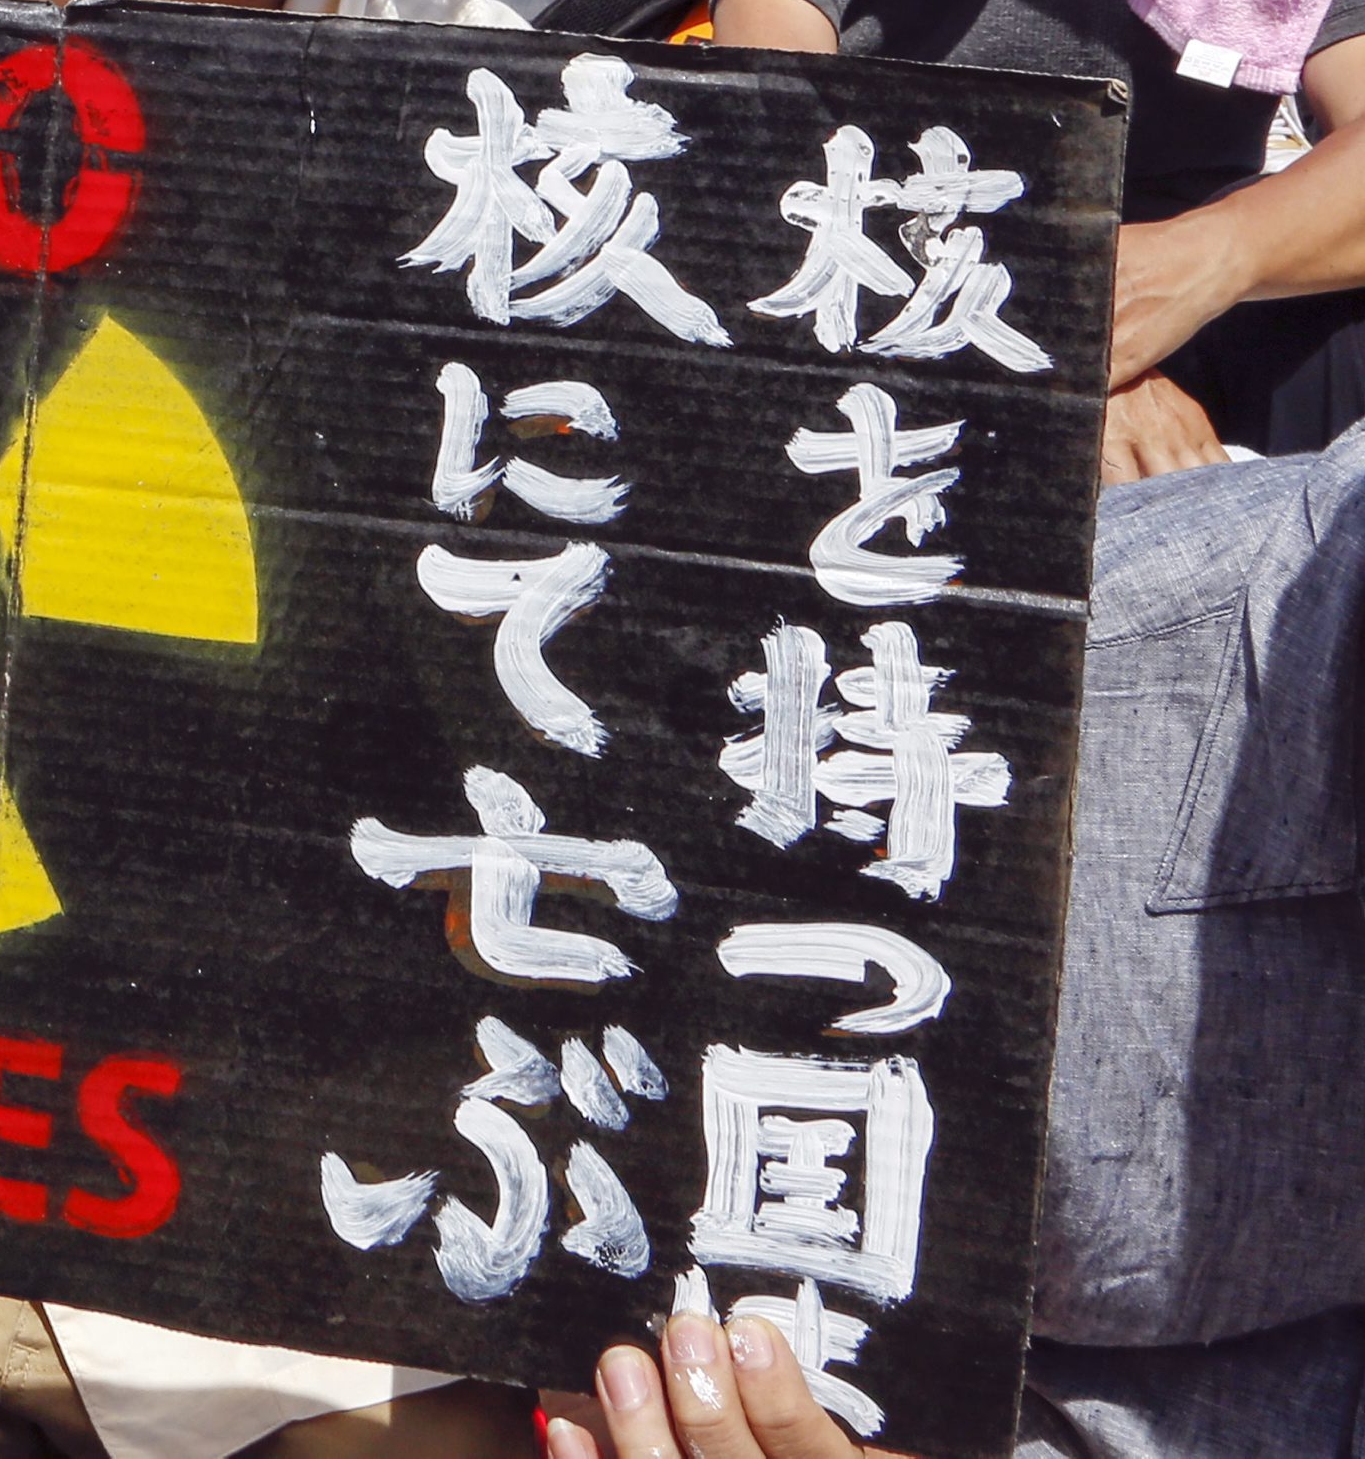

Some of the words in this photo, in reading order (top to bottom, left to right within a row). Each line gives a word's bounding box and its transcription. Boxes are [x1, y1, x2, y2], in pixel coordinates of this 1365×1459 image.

[320, 52, 733, 1303] 核にて亡ぶ
